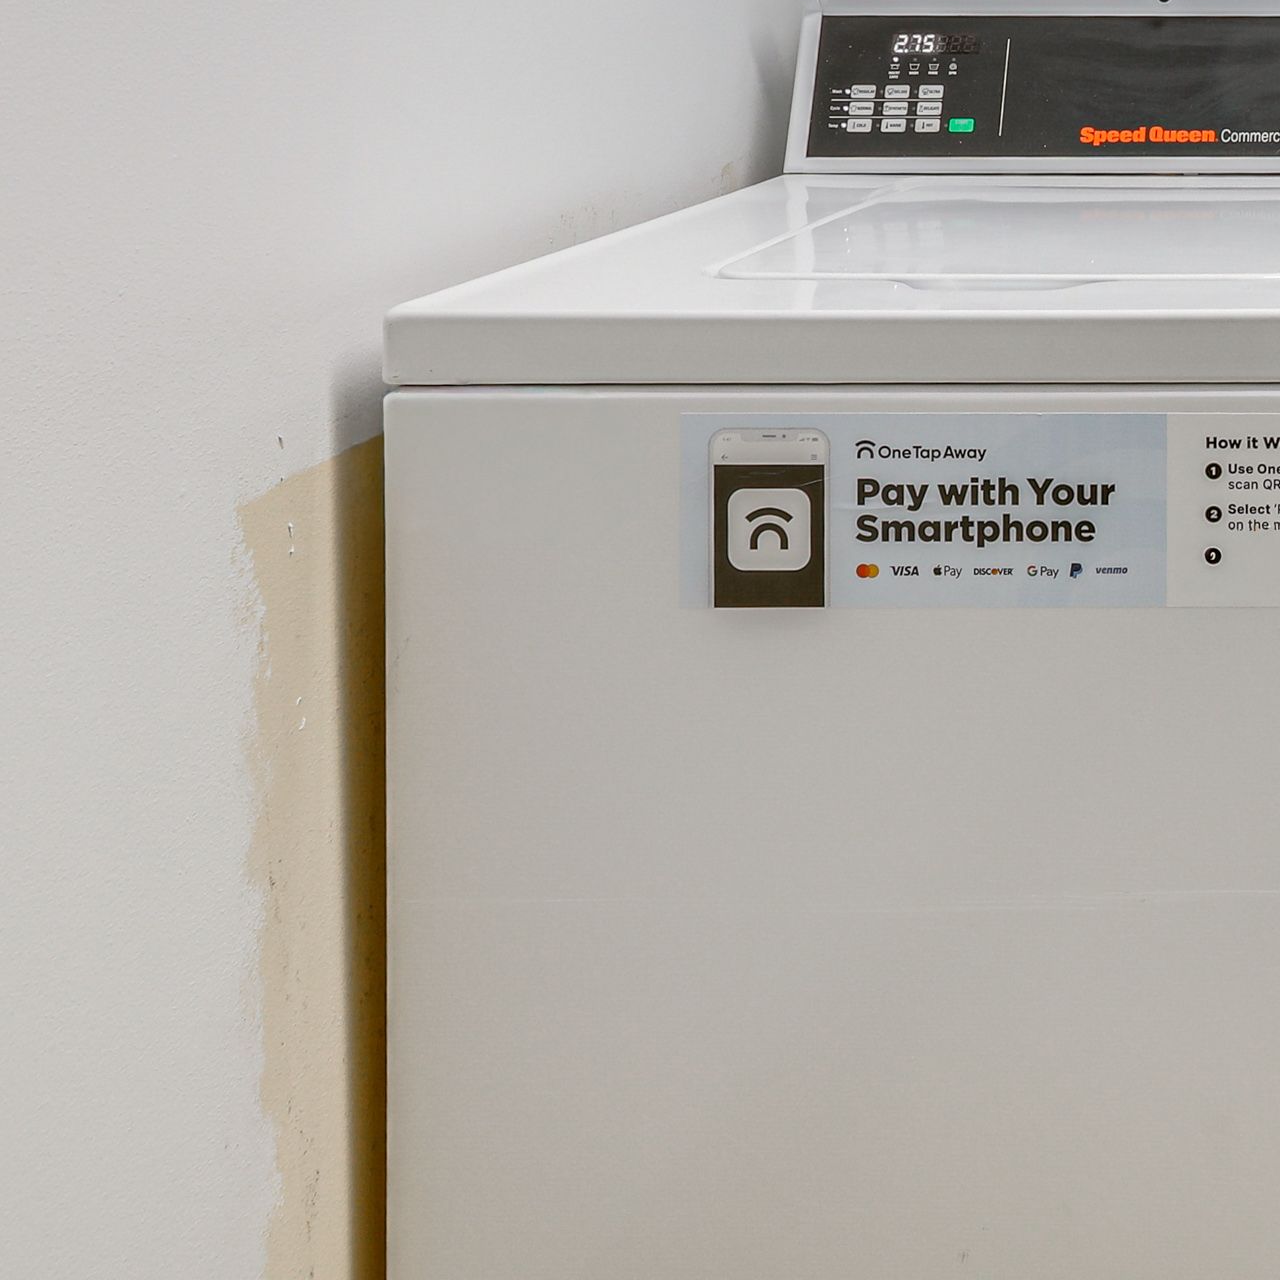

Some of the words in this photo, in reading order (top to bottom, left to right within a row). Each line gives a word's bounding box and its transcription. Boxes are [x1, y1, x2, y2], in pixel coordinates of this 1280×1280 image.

[1079, 126, 1147, 147] Speed
[1149, 125, 1216, 143] Queen
[1205, 436, 1242, 450] How
[1246, 436, 1259, 450] it
[1228, 463, 1254, 475] Use
[1228, 480, 1259, 490] scan
[1262, 479, 1280, 491] QR
[856, 478, 929, 511] Pay
[937, 476, 1020, 506] with
[1027, 477, 1116, 506] Your
[1228, 503, 1271, 515] Select
[855, 513, 1096, 548] Smartphone
[889, 565, 920, 577] VISA
[1095, 565, 1129, 575] venmo
